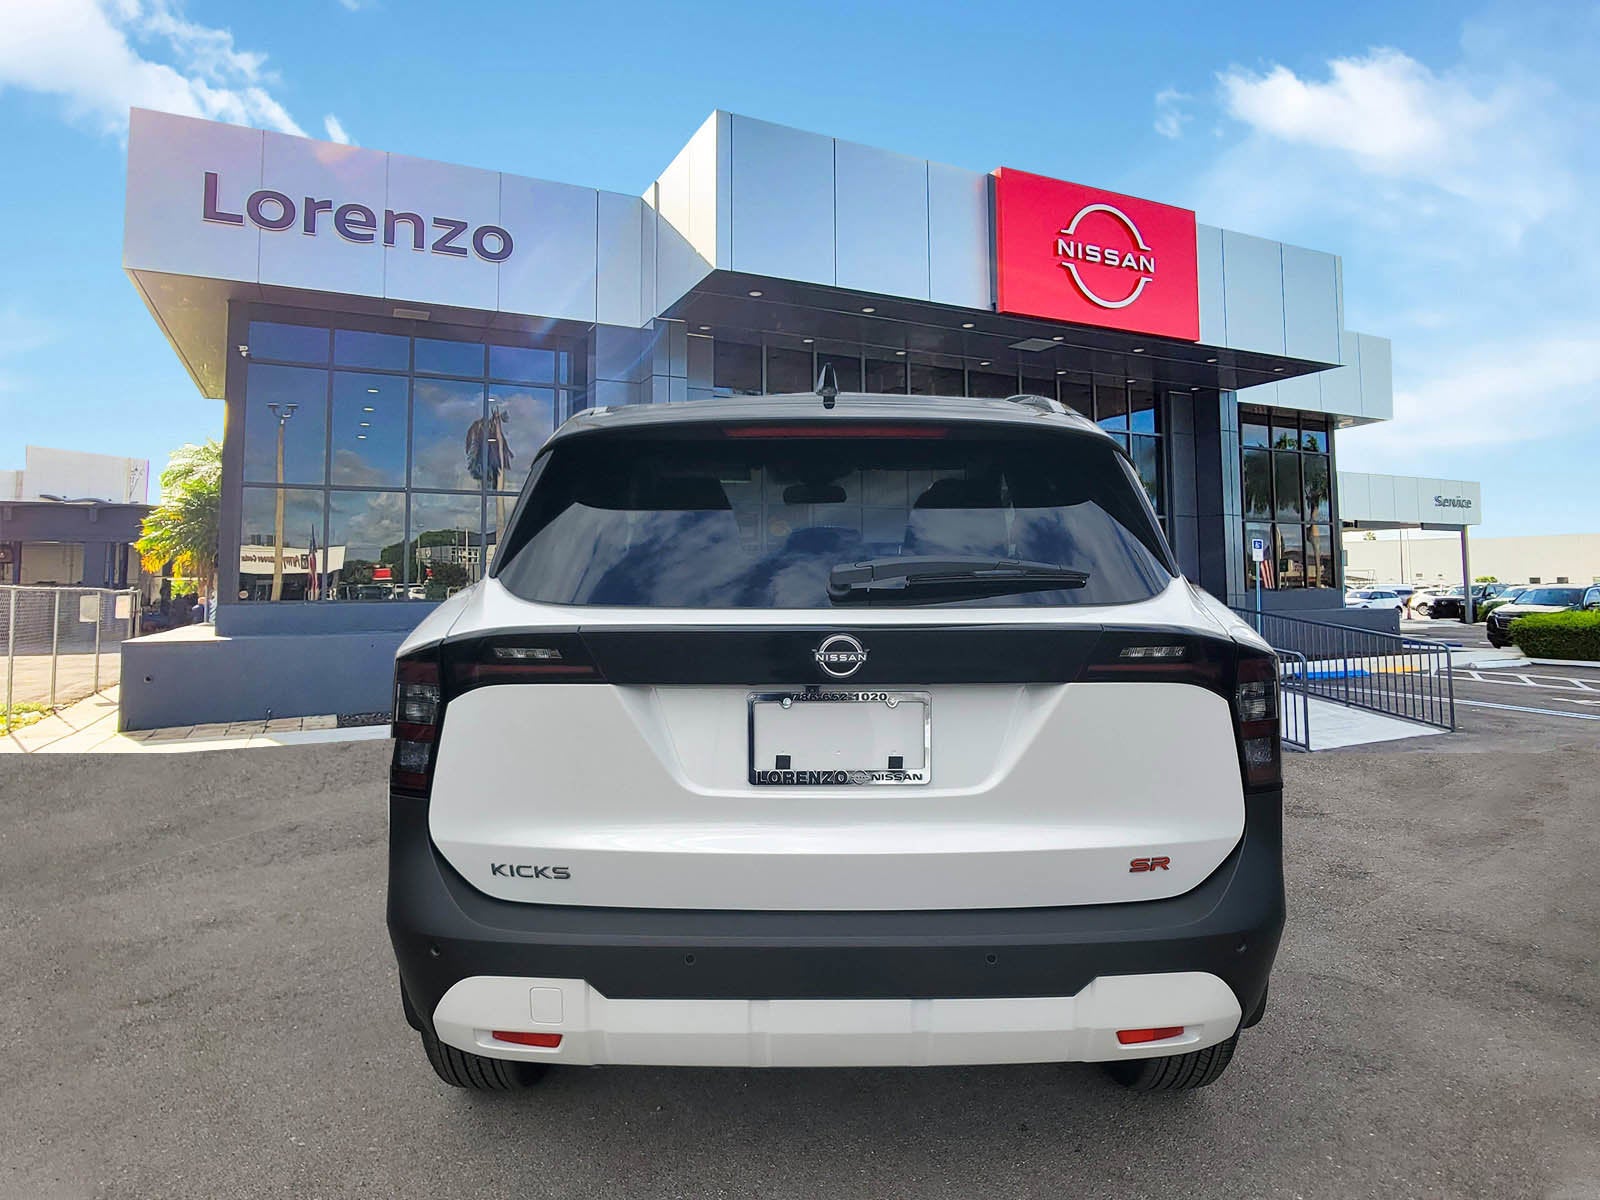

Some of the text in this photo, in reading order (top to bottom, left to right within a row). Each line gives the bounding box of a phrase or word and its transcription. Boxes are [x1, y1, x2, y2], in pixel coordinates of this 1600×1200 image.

[202, 171, 514, 262] Lorenzo
[1057, 238, 1155, 273] NISSAN
[1434, 495, 1472, 508] Service
[756, 770, 848, 784] LORENZO
[871, 773, 923, 781] NISSAN
[490, 863, 571, 880] KICKS
[1129, 856, 1170, 872] SR
